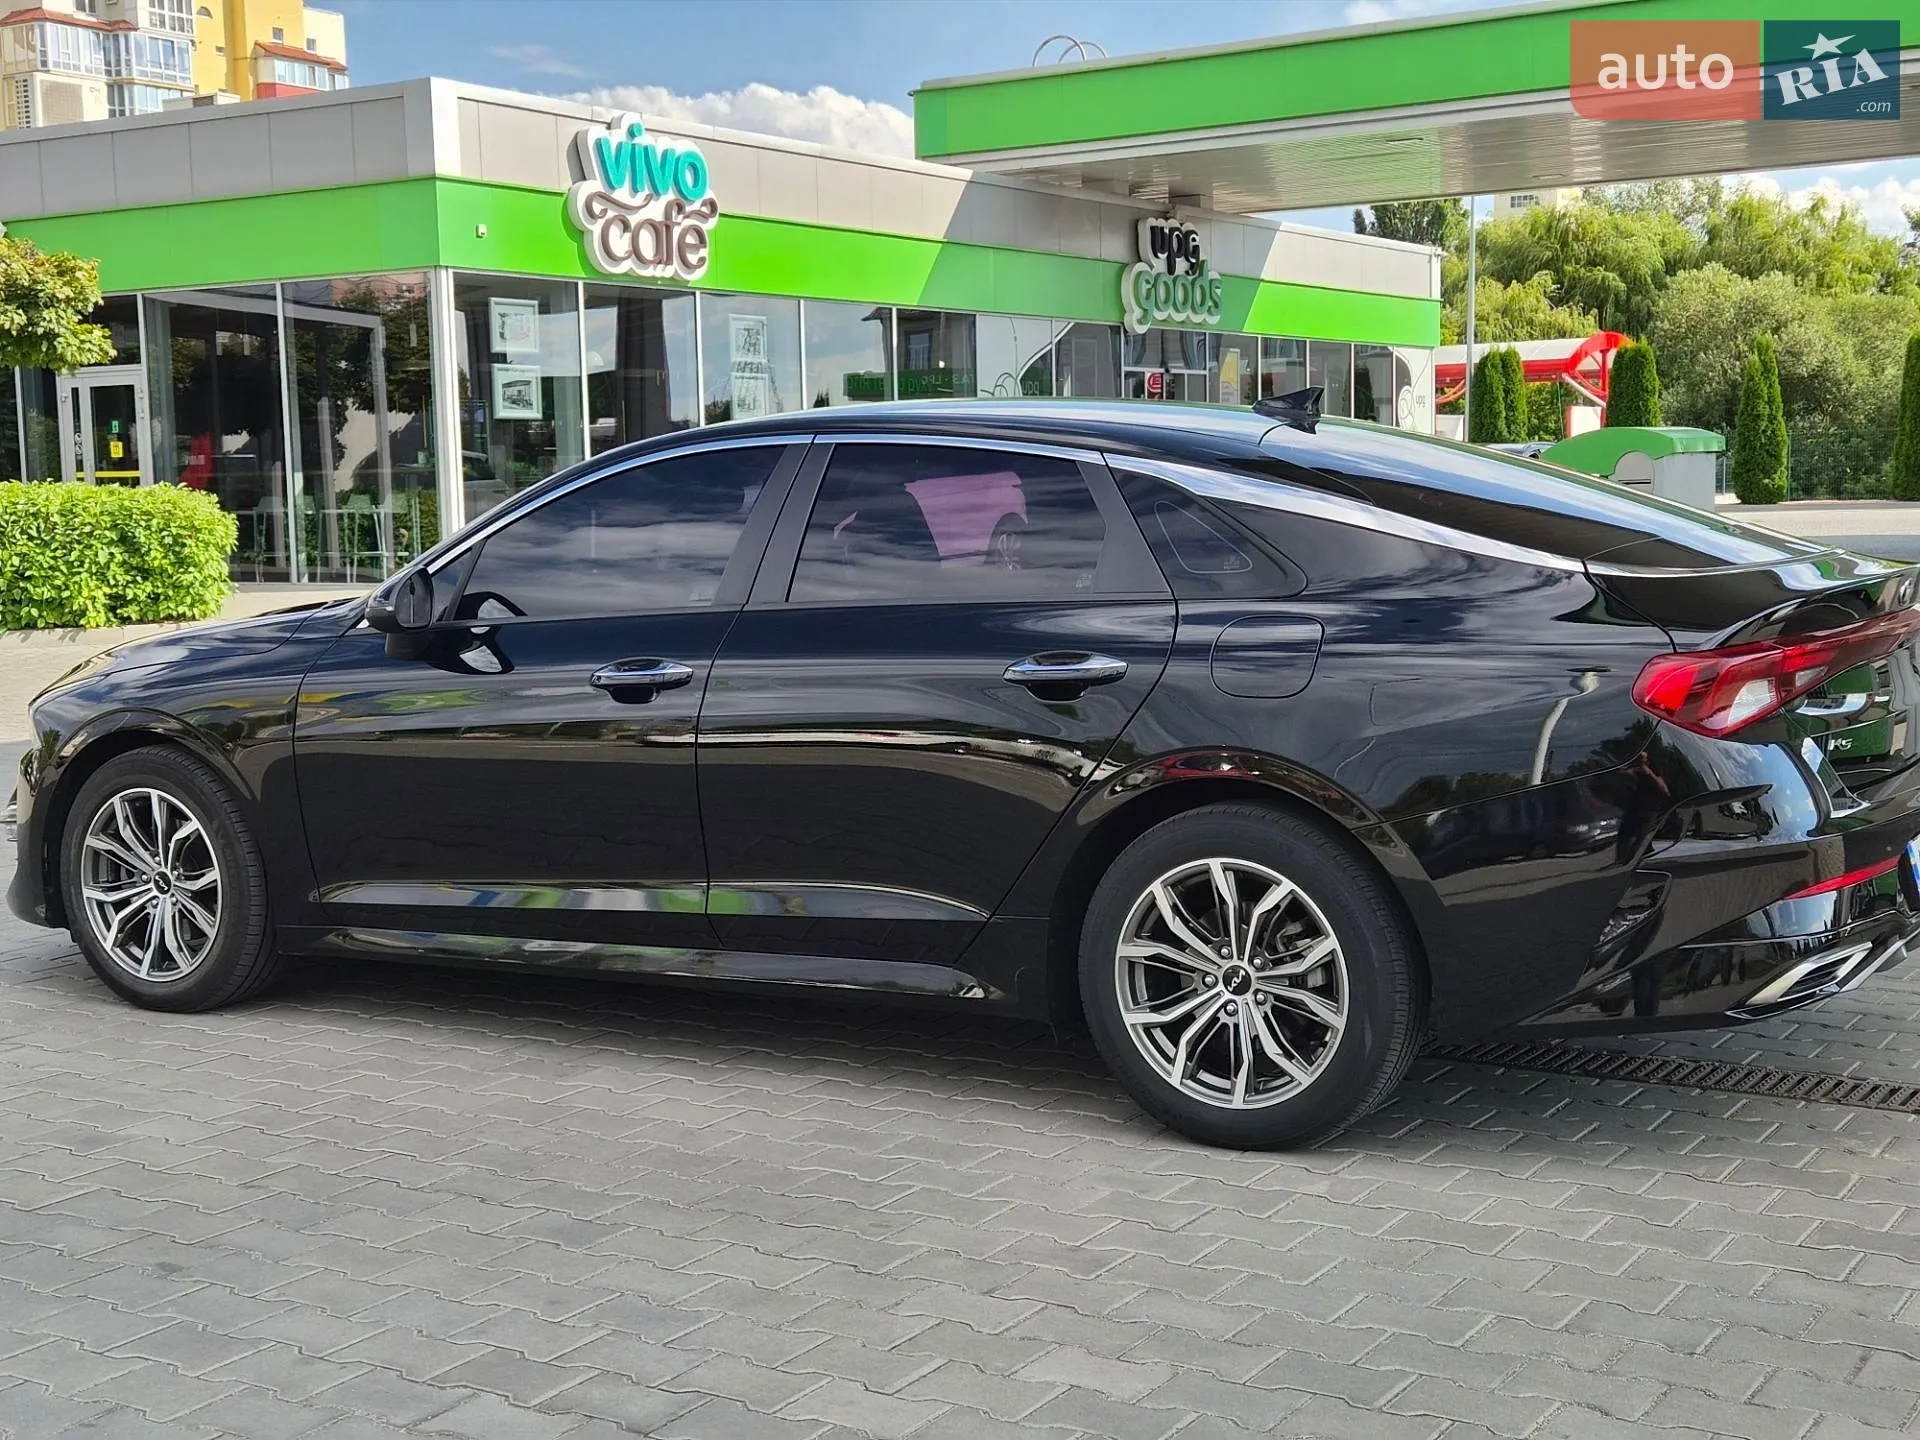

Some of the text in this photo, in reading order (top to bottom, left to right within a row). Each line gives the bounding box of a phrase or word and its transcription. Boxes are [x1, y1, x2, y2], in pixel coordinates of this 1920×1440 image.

[595, 122, 710, 202] vivo
[1150, 224, 1201, 276] upg
[1134, 259, 1223, 325] goods
